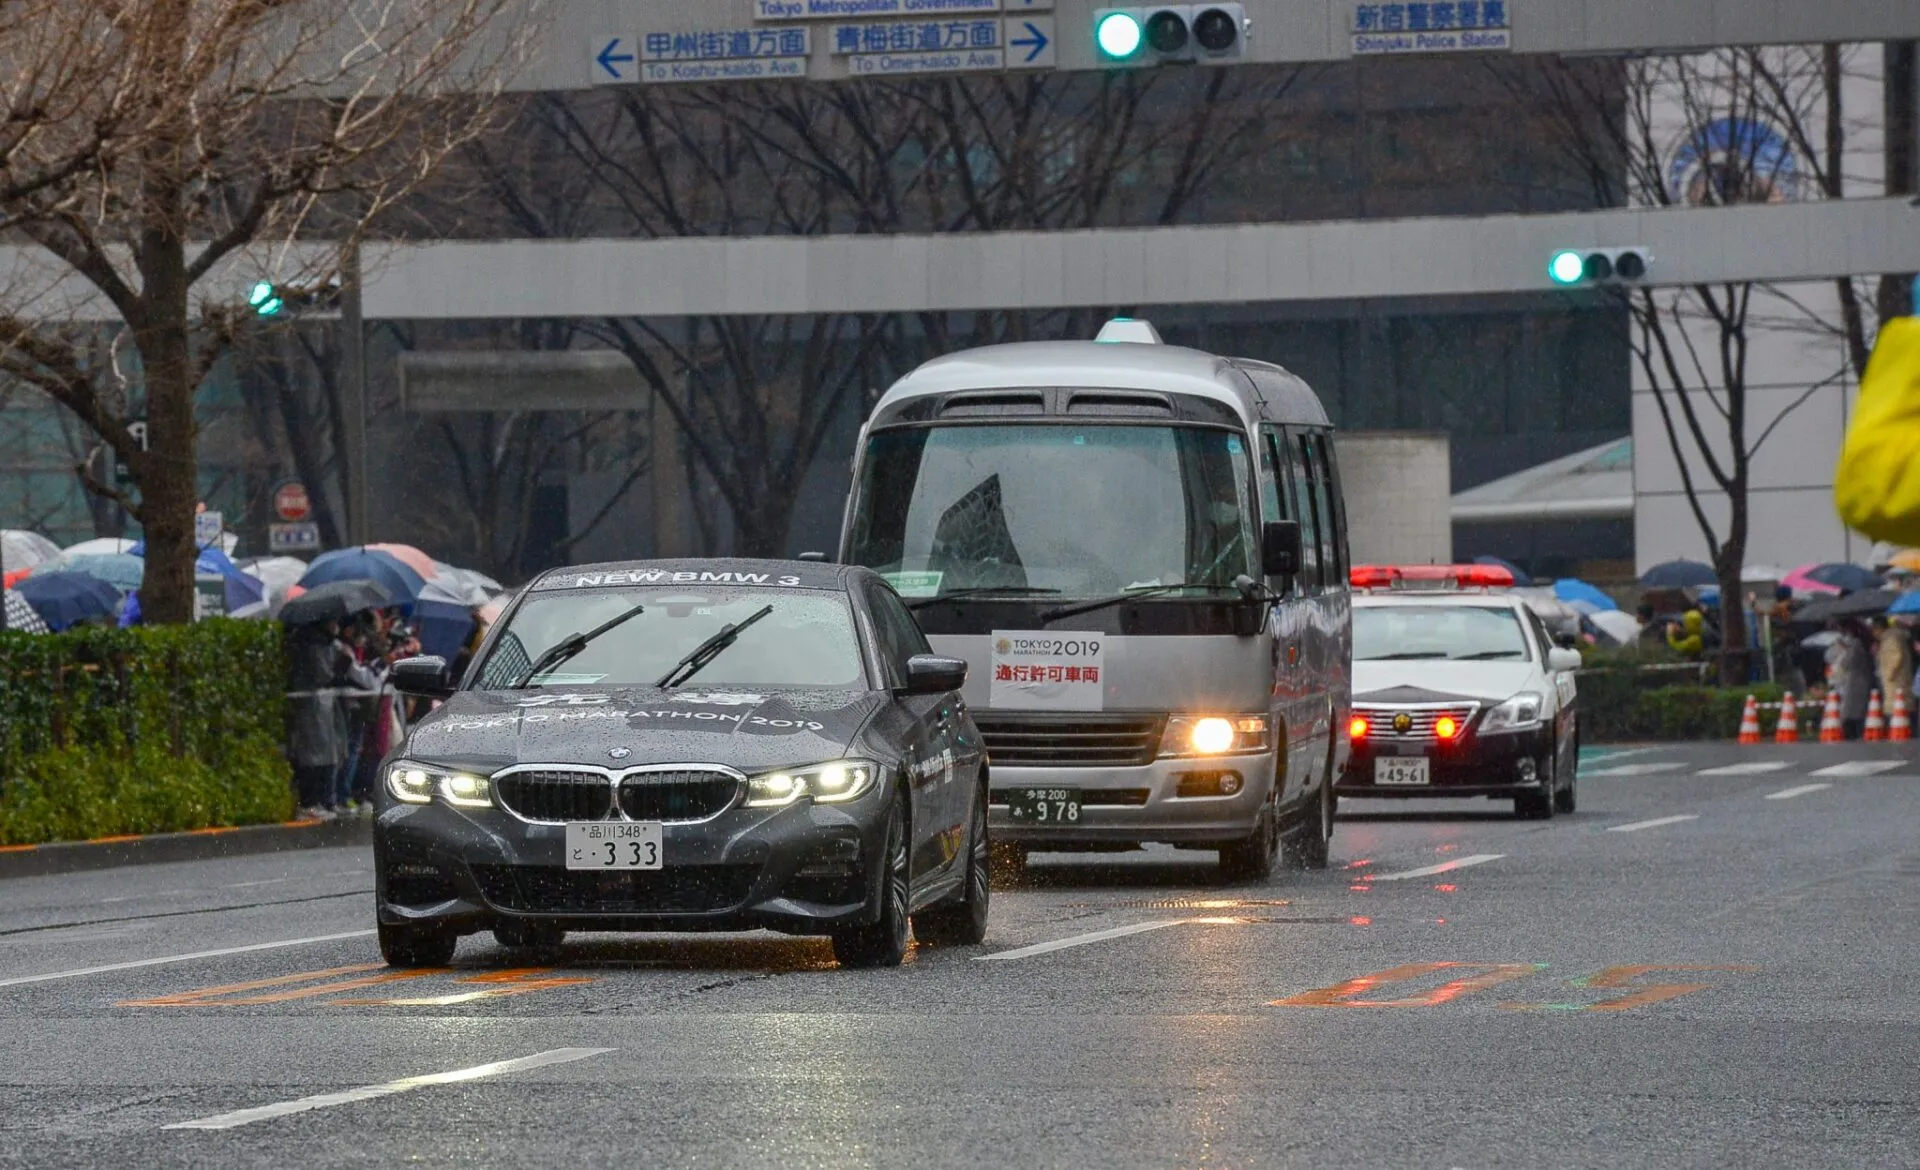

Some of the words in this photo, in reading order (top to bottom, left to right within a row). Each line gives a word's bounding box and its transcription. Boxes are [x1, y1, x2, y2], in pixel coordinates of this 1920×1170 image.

[759, 1, 803, 17] Tokyo
[808, 0, 899, 13] Metropolitan
[904, 0, 995, 10] Government
[646, 28, 805, 58] 甲州街道方面
[836, 20, 996, 51] 青梅街道方面
[1355, 35, 1413, 51] Shinjuku
[1417, 33, 1456, 48] Police
[1461, 31, 1506, 46] Station
[647, 65, 668, 79] To
[672, 62, 764, 78] Koshu-kaido
[855, 57, 874, 71] To
[880, 54, 960, 71] Ome-kaido
[575, 572, 664, 587] NEW
[672, 571, 770, 583] BMW
[777, 575, 801, 586] 3
[1013, 640, 1051, 648] TOKYO
[1053, 641, 1100, 656] 2019
[996, 664, 1100, 683] 通行許可車両
[443, 715, 548, 732] TOKYO
[560, 710, 741, 722] MARATHON
[749, 716, 824, 731] 2019
[1387, 767, 1425, 782] 49-61
[573, 848, 583, 860] と
